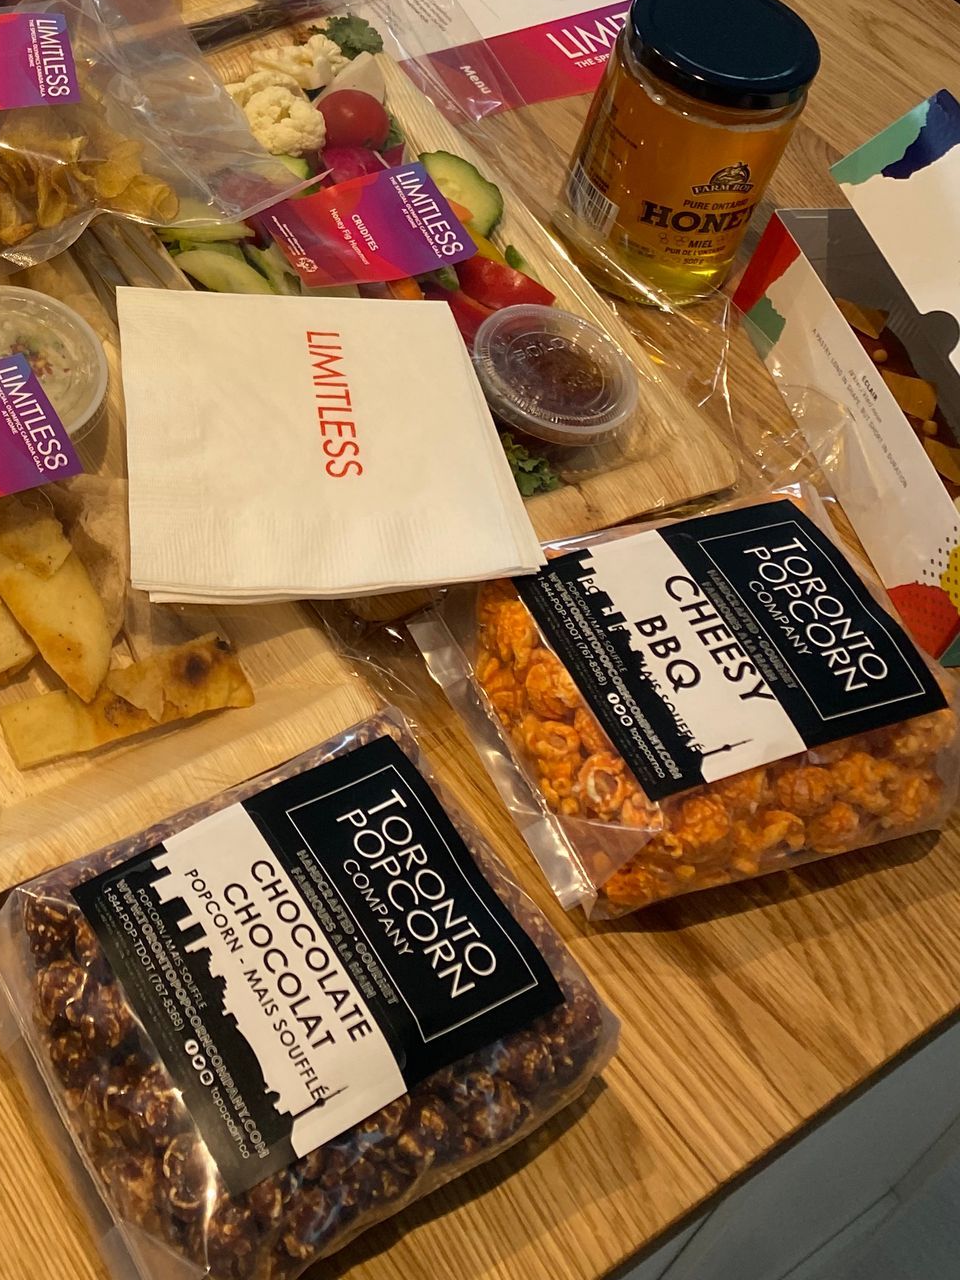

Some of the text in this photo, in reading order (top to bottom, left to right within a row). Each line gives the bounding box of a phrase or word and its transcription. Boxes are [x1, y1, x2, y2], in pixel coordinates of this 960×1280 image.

[460, 65, 492, 94] Menu
[574, 58, 596, 68] THE
[328, 208, 346, 229] Honey
[341, 229, 353, 240] Fig
[389, 176, 442, 258] THE SPECIAL OLYMPICS CANADA GALA
[406, 214, 417, 228] HOME
[639, 200, 756, 233] HONEY
[683, 200, 711, 210] PURE
[695, 185, 729, 194] FARM
[352, 214, 378, 251] CRUDITES
[688, 240, 713, 248] MIEL
[1, 409, 18, 434] AT HOME
[6, 404, 23, 432] OLYMPICS
[20, 431, 35, 456] CANADA
[33, 455, 44, 473] GALA
[306, 331, 363, 477] LIMITLESS
[538, 577, 582, 639] 1-844-POP-TDOT
[576, 642, 607, 685] (767-8368)
[666, 575, 775, 699] CHEESY
[744, 547, 867, 691] POPCORN
[749, 581, 812, 654] COMPANY
[772, 538, 887, 679] TORONTO
[635, 615, 700, 692] BBQ
[291, 867, 336, 932] FABRIQUES
[337, 809, 474, 997] POPCORN
[343, 859, 413, 954] COMPANY
[368, 792, 496, 975] TORONTO
[104, 888, 155, 971] 1-844-POP-TDOT
[148, 974, 184, 1031] (767-8368)
[224, 884, 334, 1047] CHOCOLAT
[251, 861, 371, 1040] CHOCOLATE
[297, 850, 398, 1004] HANDCRAFTED GOURMET
[117, 880, 269, 1157] WWW.TORONTOPOPCORNCOMPANY.COM
[179, 966, 207, 1009] SOUFFLE
[185, 869, 329, 1100] POPCORN MAIS SOUFFLÉ
